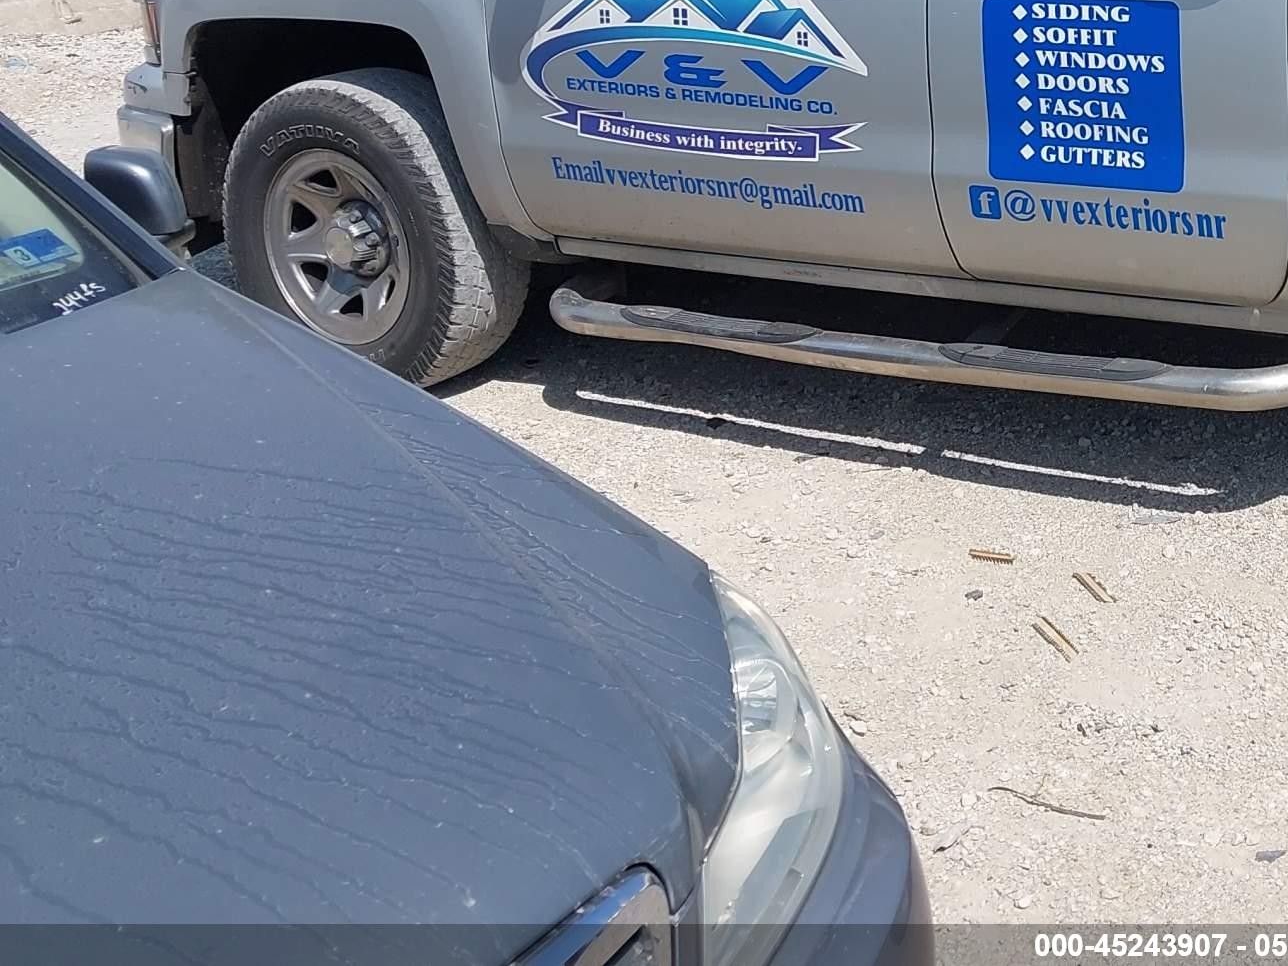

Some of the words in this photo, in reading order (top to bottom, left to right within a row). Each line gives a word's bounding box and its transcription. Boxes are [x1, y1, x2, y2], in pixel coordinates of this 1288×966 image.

[1031, 2, 1131, 23] SIDING
[1032, 26, 1117, 47] SOFFIT
[575, 49, 646, 79] V
[663, 53, 728, 88] &
[740, 59, 830, 96] V
[1036, 49, 1165, 74] WINDOWS
[567, 78, 660, 100] EXTERIORS
[664, 87, 677, 100] &
[681, 89, 802, 113] REMODELING
[807, 99, 838, 116] CO.
[1036, 74, 1130, 96] DOORS
[1038, 97, 1127, 120] FASCIA
[598, 118, 671, 145] Business
[676, 131, 715, 150] with
[719, 135, 803, 156] integrity.
[1040, 120, 1149, 146] ROOFING
[1040, 145, 1146, 170] GUTTERS
